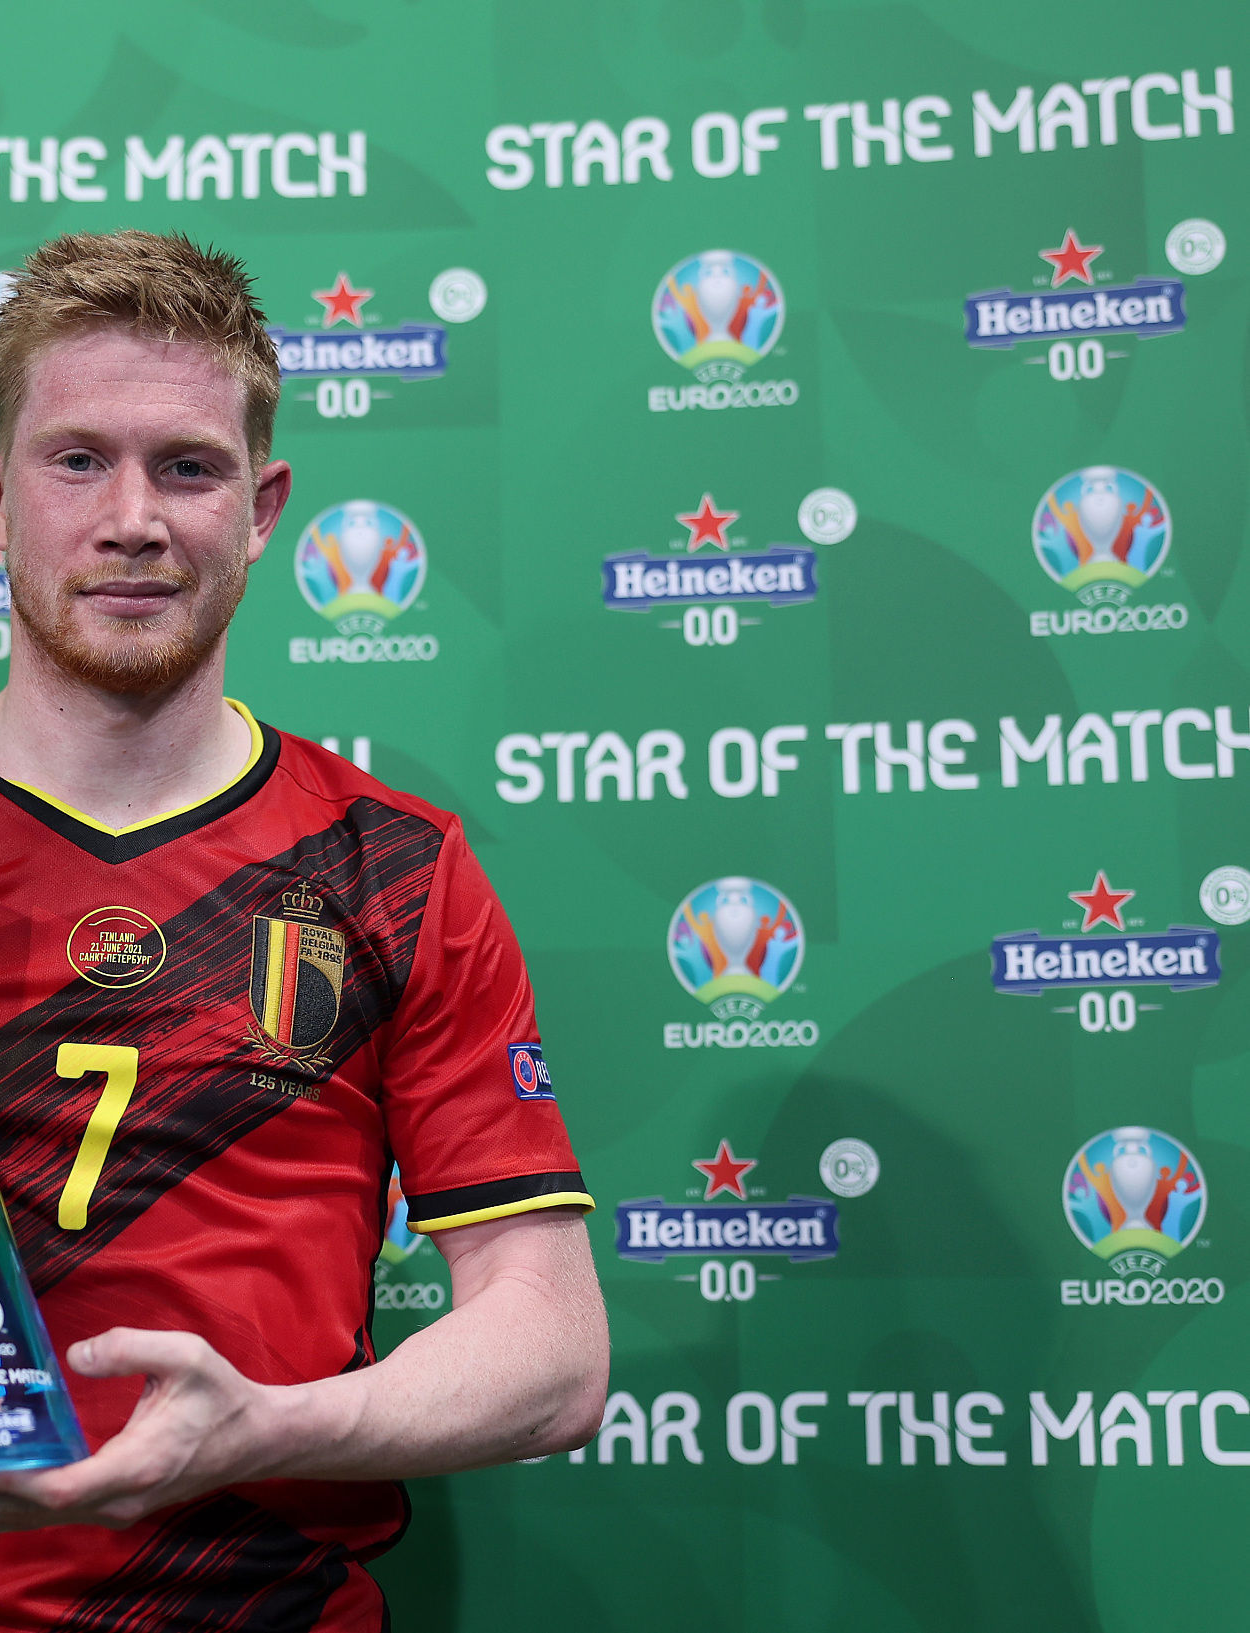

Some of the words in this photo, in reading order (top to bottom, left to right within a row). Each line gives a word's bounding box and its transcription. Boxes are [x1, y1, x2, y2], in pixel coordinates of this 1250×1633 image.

[484, 116, 674, 191] STAR
[690, 106, 789, 179] OF
[802, 94, 955, 171] THE
[971, 65, 1235, 159] MATCH
[124, 130, 368, 203] MATCH
[976, 292, 1173, 337] Heineken
[272, 334, 434, 371] eineken
[1047, 338, 1106, 382] 0.0
[315, 378, 372, 419] 0.0
[648, 379, 799, 412] EURO2020
[614, 558, 805, 598] Heineken
[682, 604, 739, 647] 0.0
[1030, 603, 1188, 637] EURO2020
[494, 729, 689, 805] STAR
[707, 724, 809, 799] OF
[824, 718, 980, 795] THE
[998, 705, 1250, 789] MATCH
[90, 942, 100, 952] 21
[101, 942, 123, 953] JUNE
[123, 944, 143, 955] 2021
[99, 931, 135, 943] FINLAND
[301, 937, 343, 954] BELGIAN
[302, 926, 334, 942] ROYAL
[78, 952, 153, 965] САНКТ-ПЕТЕРБУРГ
[1003, 940, 1208, 981] Heineken
[1078, 989, 1137, 1034] 0.0
[663, 1019, 819, 1049] EURO2020
[249, 1072, 277, 1091] 125
[279, 1079, 322, 1102] YEARS
[55, 1042, 139, 1231] 7
[627, 1210, 825, 1248] Heineken
[699, 1259, 757, 1303] 0.0
[1112, 1255, 1161, 1275] UEFA
[375, 1283, 445, 1310] 2020
[1060, 1277, 1225, 1306] EURO2020
[725, 1390, 829, 1466] OF
[846, 1390, 1008, 1467] THE
[1028, 1389, 1250, 1468] MATC
